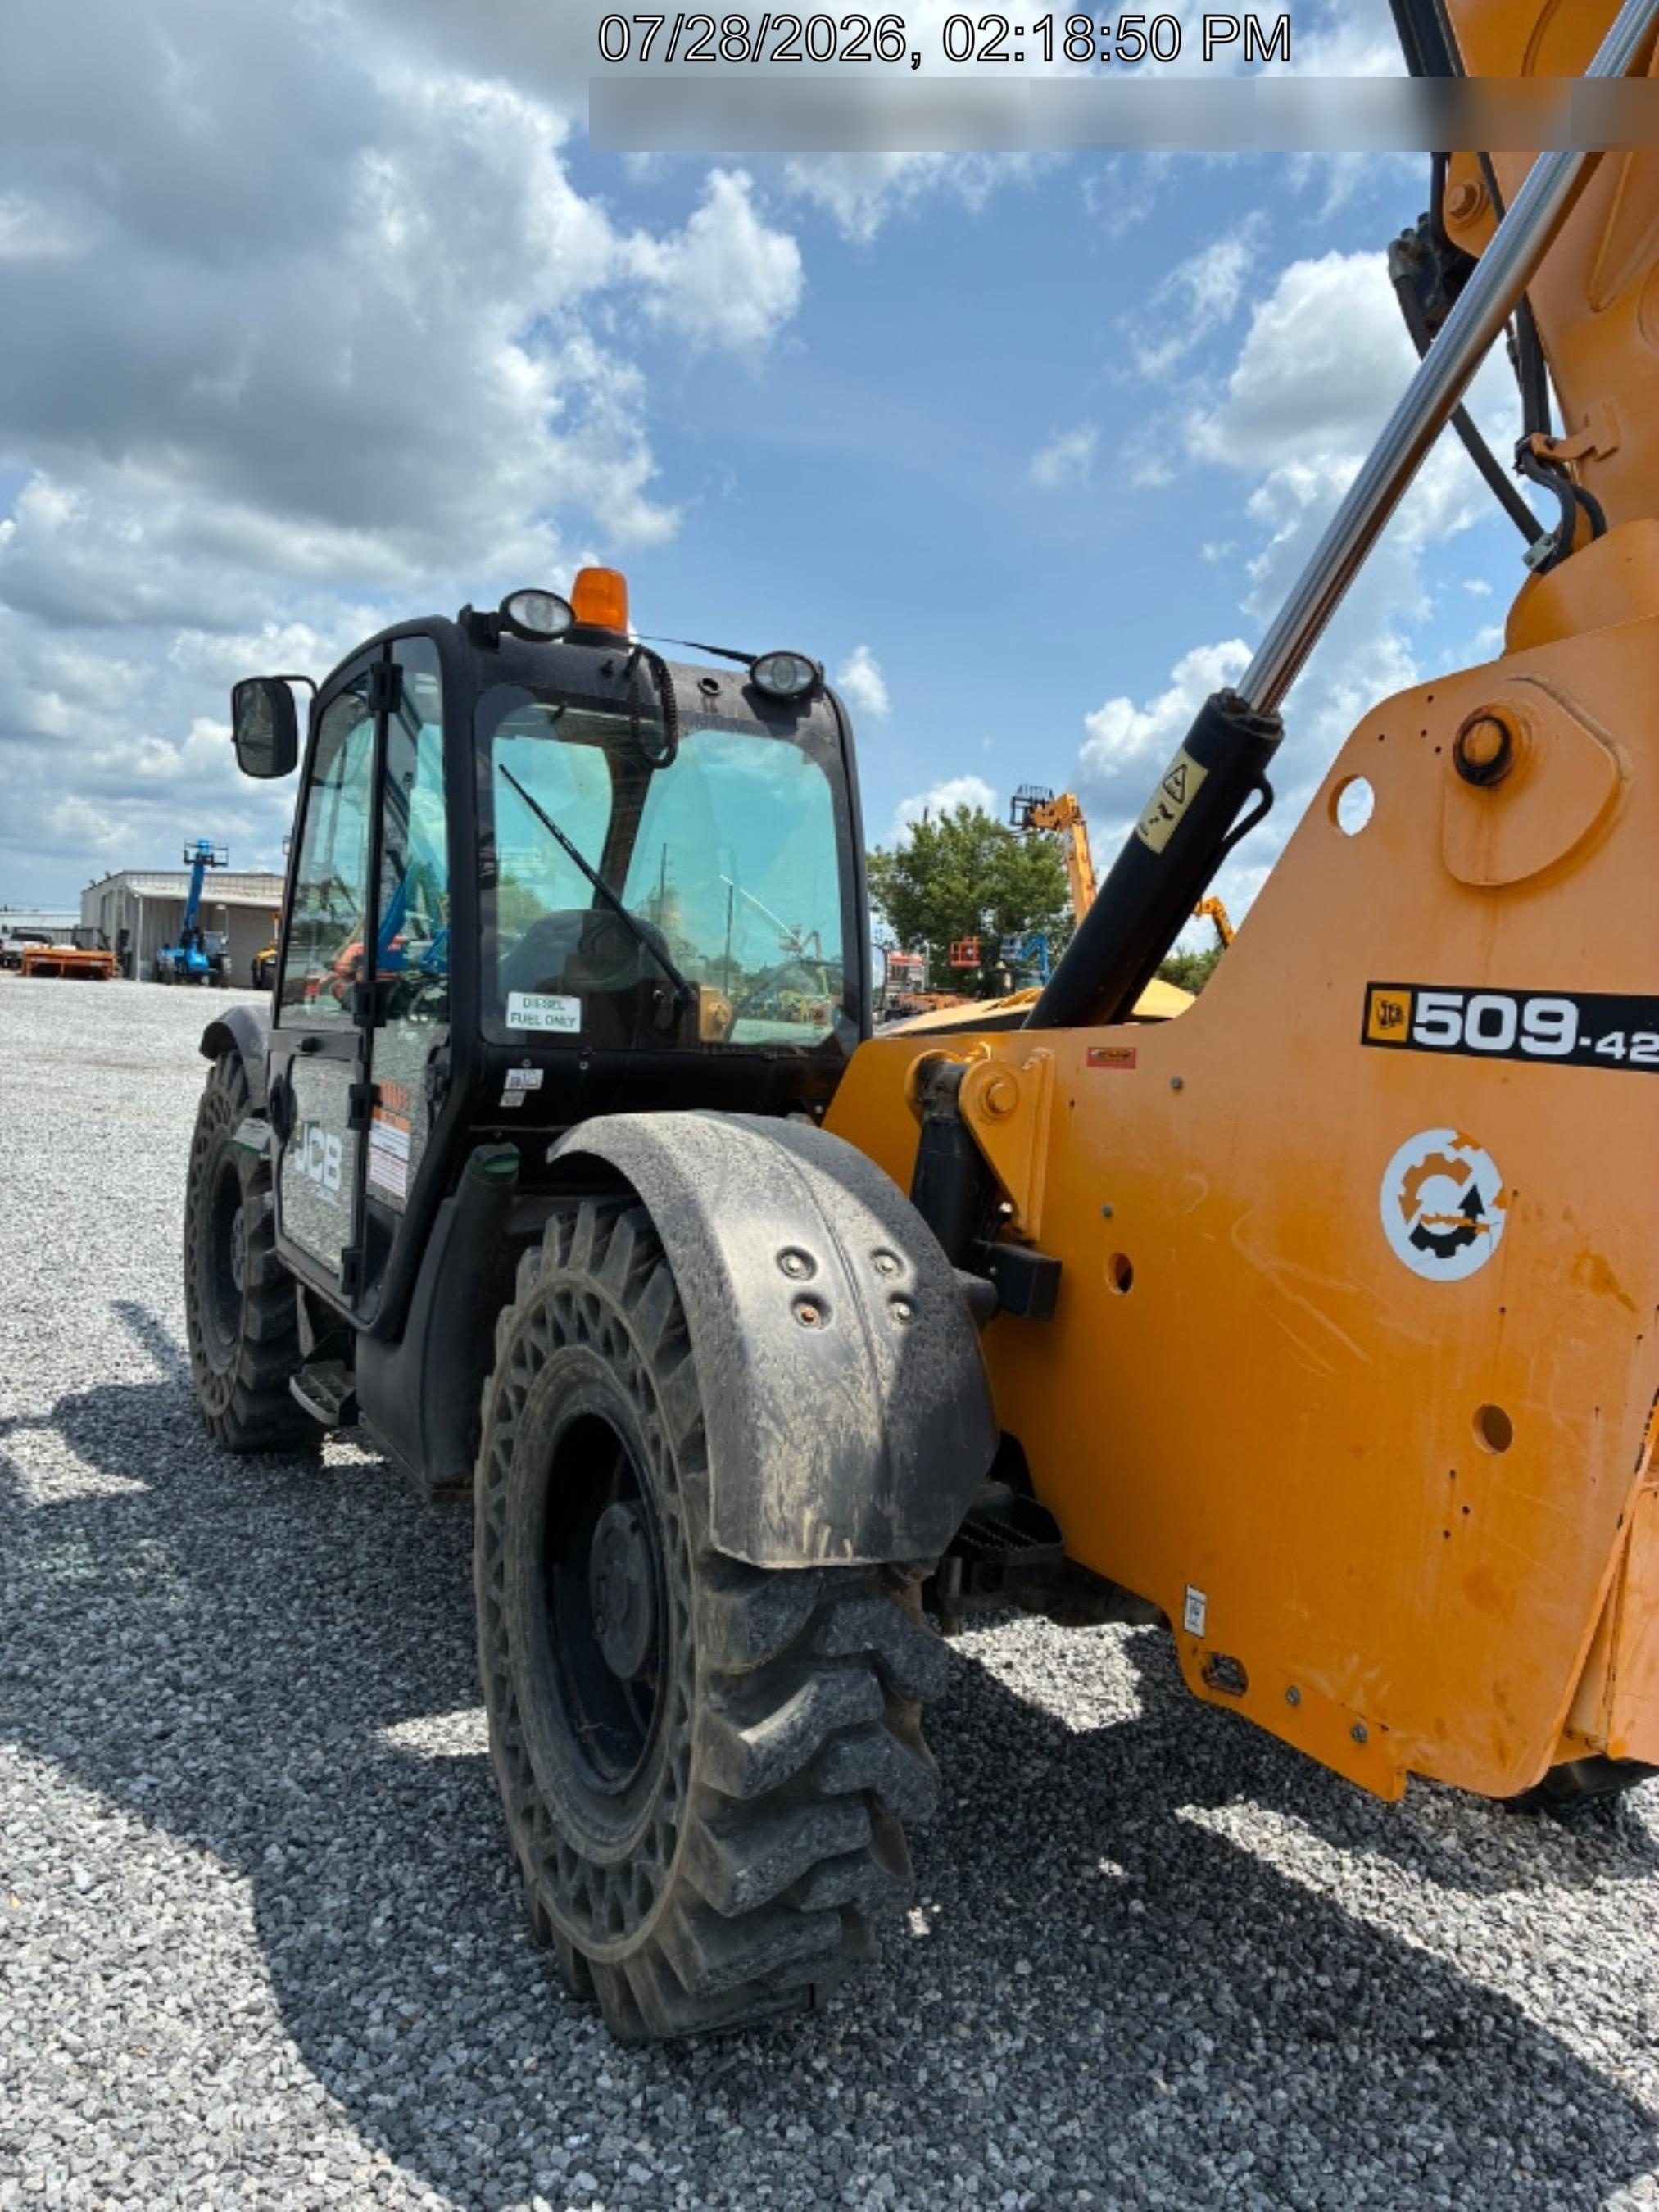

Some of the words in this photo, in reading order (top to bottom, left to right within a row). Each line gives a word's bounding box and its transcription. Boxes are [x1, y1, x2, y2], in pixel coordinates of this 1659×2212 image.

[523, 997, 566, 1011] DIESEL
[510, 1012, 541, 1026] FUEL
[545, 1014, 576, 1028] ONLY
[295, 1122, 342, 1191] JCB
